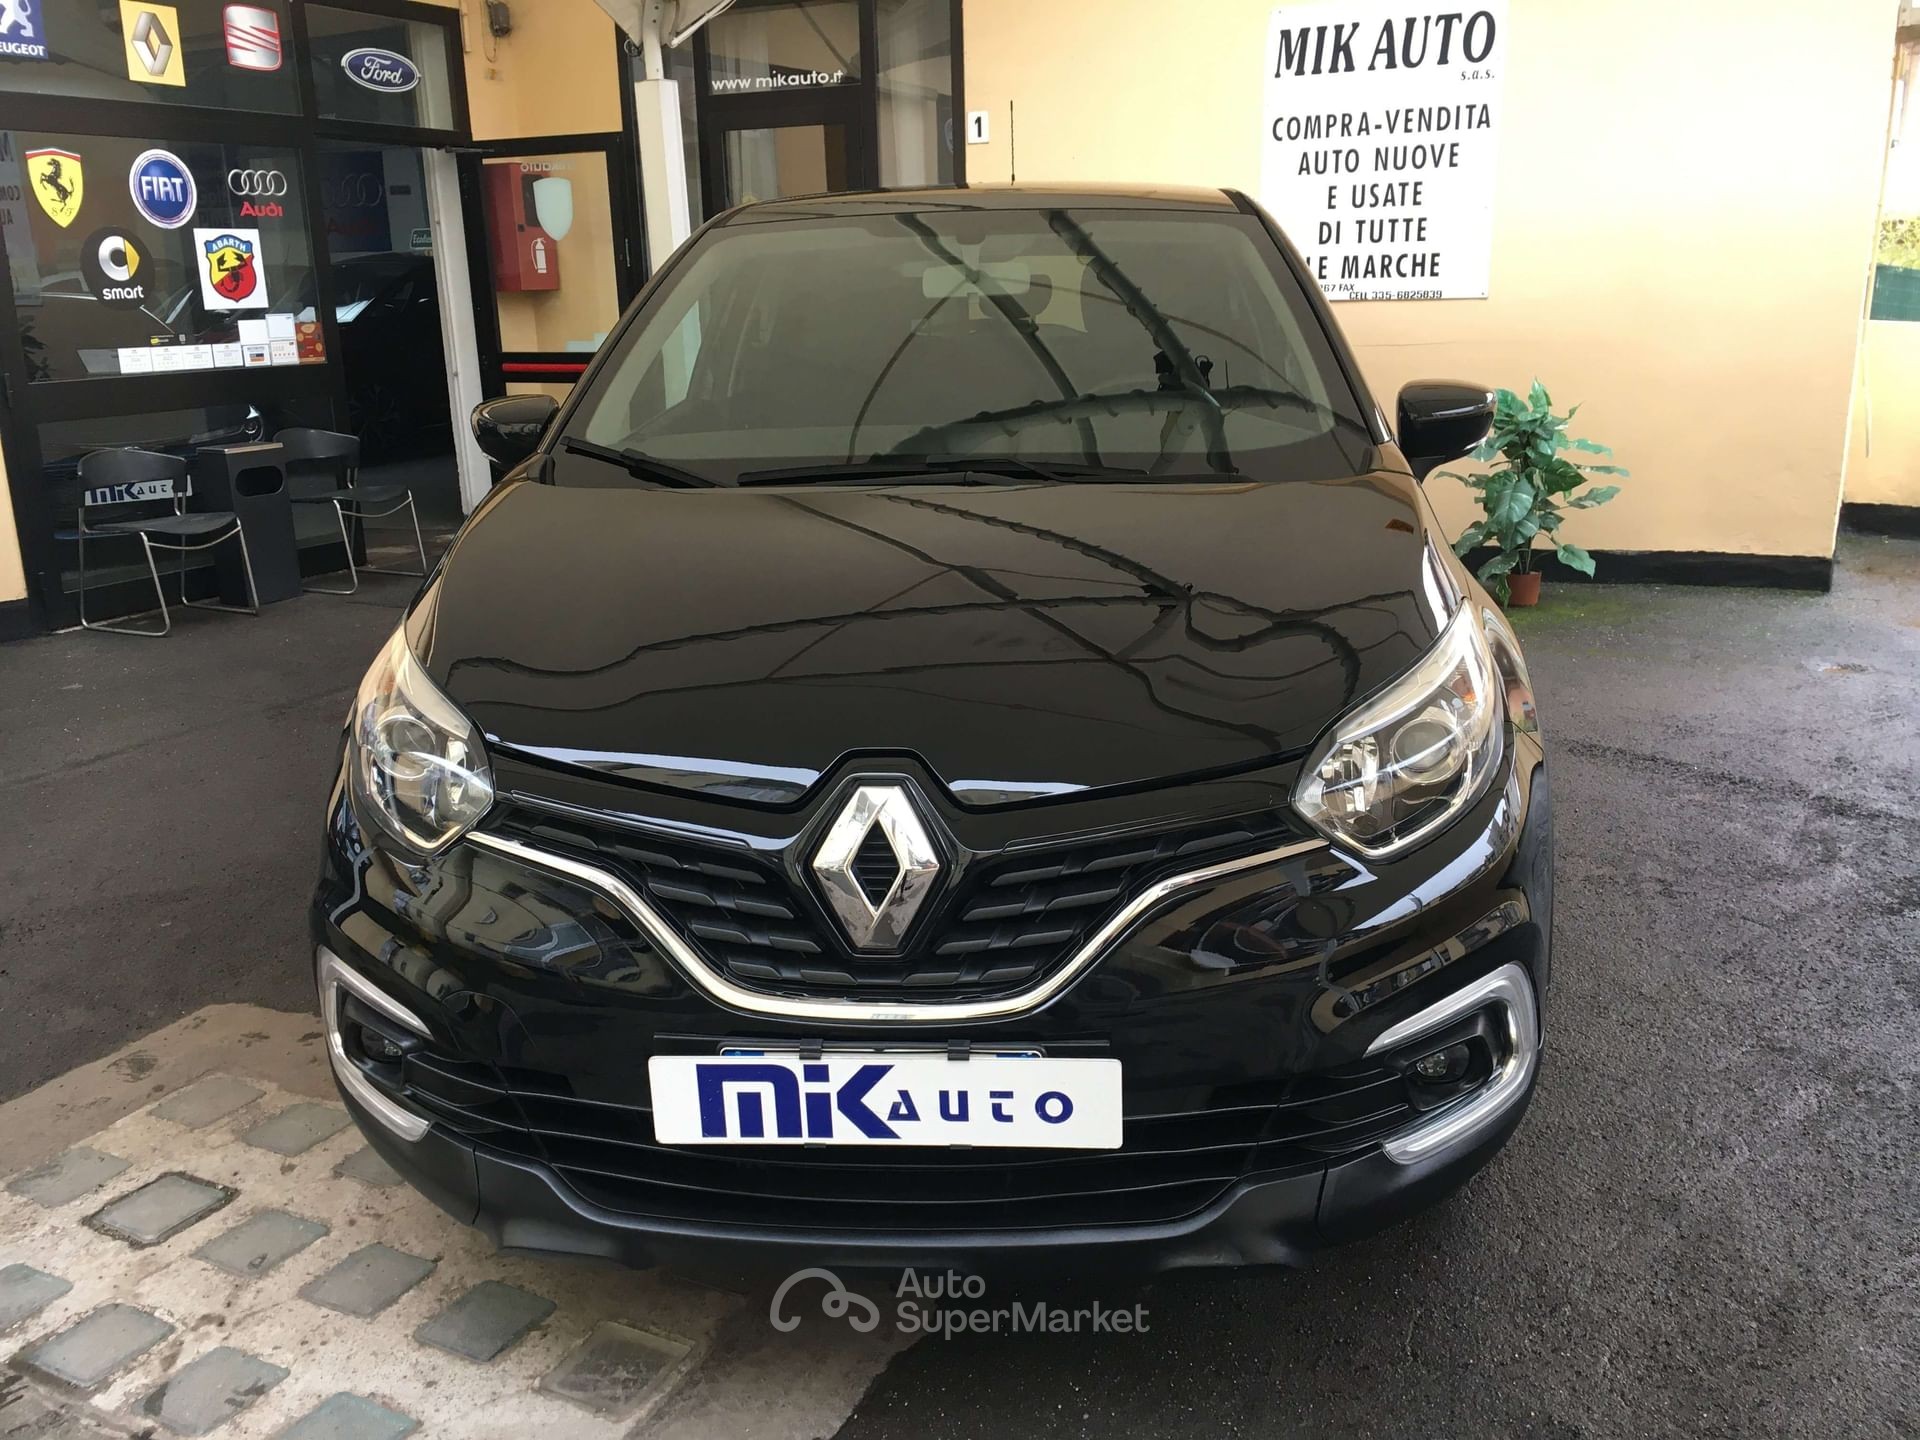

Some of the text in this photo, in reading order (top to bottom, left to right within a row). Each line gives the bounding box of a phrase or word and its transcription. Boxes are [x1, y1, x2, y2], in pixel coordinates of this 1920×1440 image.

[1275, 10, 1496, 78] MIK AUTO
[361, 55, 403, 84] Ford
[1460, 68, 1495, 80] s.a.s.
[974, 116, 982, 138] 1
[1272, 103, 1491, 142] COMPRA-VENDITA
[1297, 142, 1460, 176] AUTO NUOVE
[140, 175, 183, 203] FIAT
[1327, 181, 1423, 210] E USATE
[240, 201, 283, 217] Audi
[211, 237, 246, 251] ABARTH
[1318, 217, 1428, 245] DI TUTTE
[1340, 252, 1441, 279] MARCHE
[102, 284, 144, 300] smart
[1338, 283, 1355, 292] FAX
[1349, 291, 1368, 300] CELL
